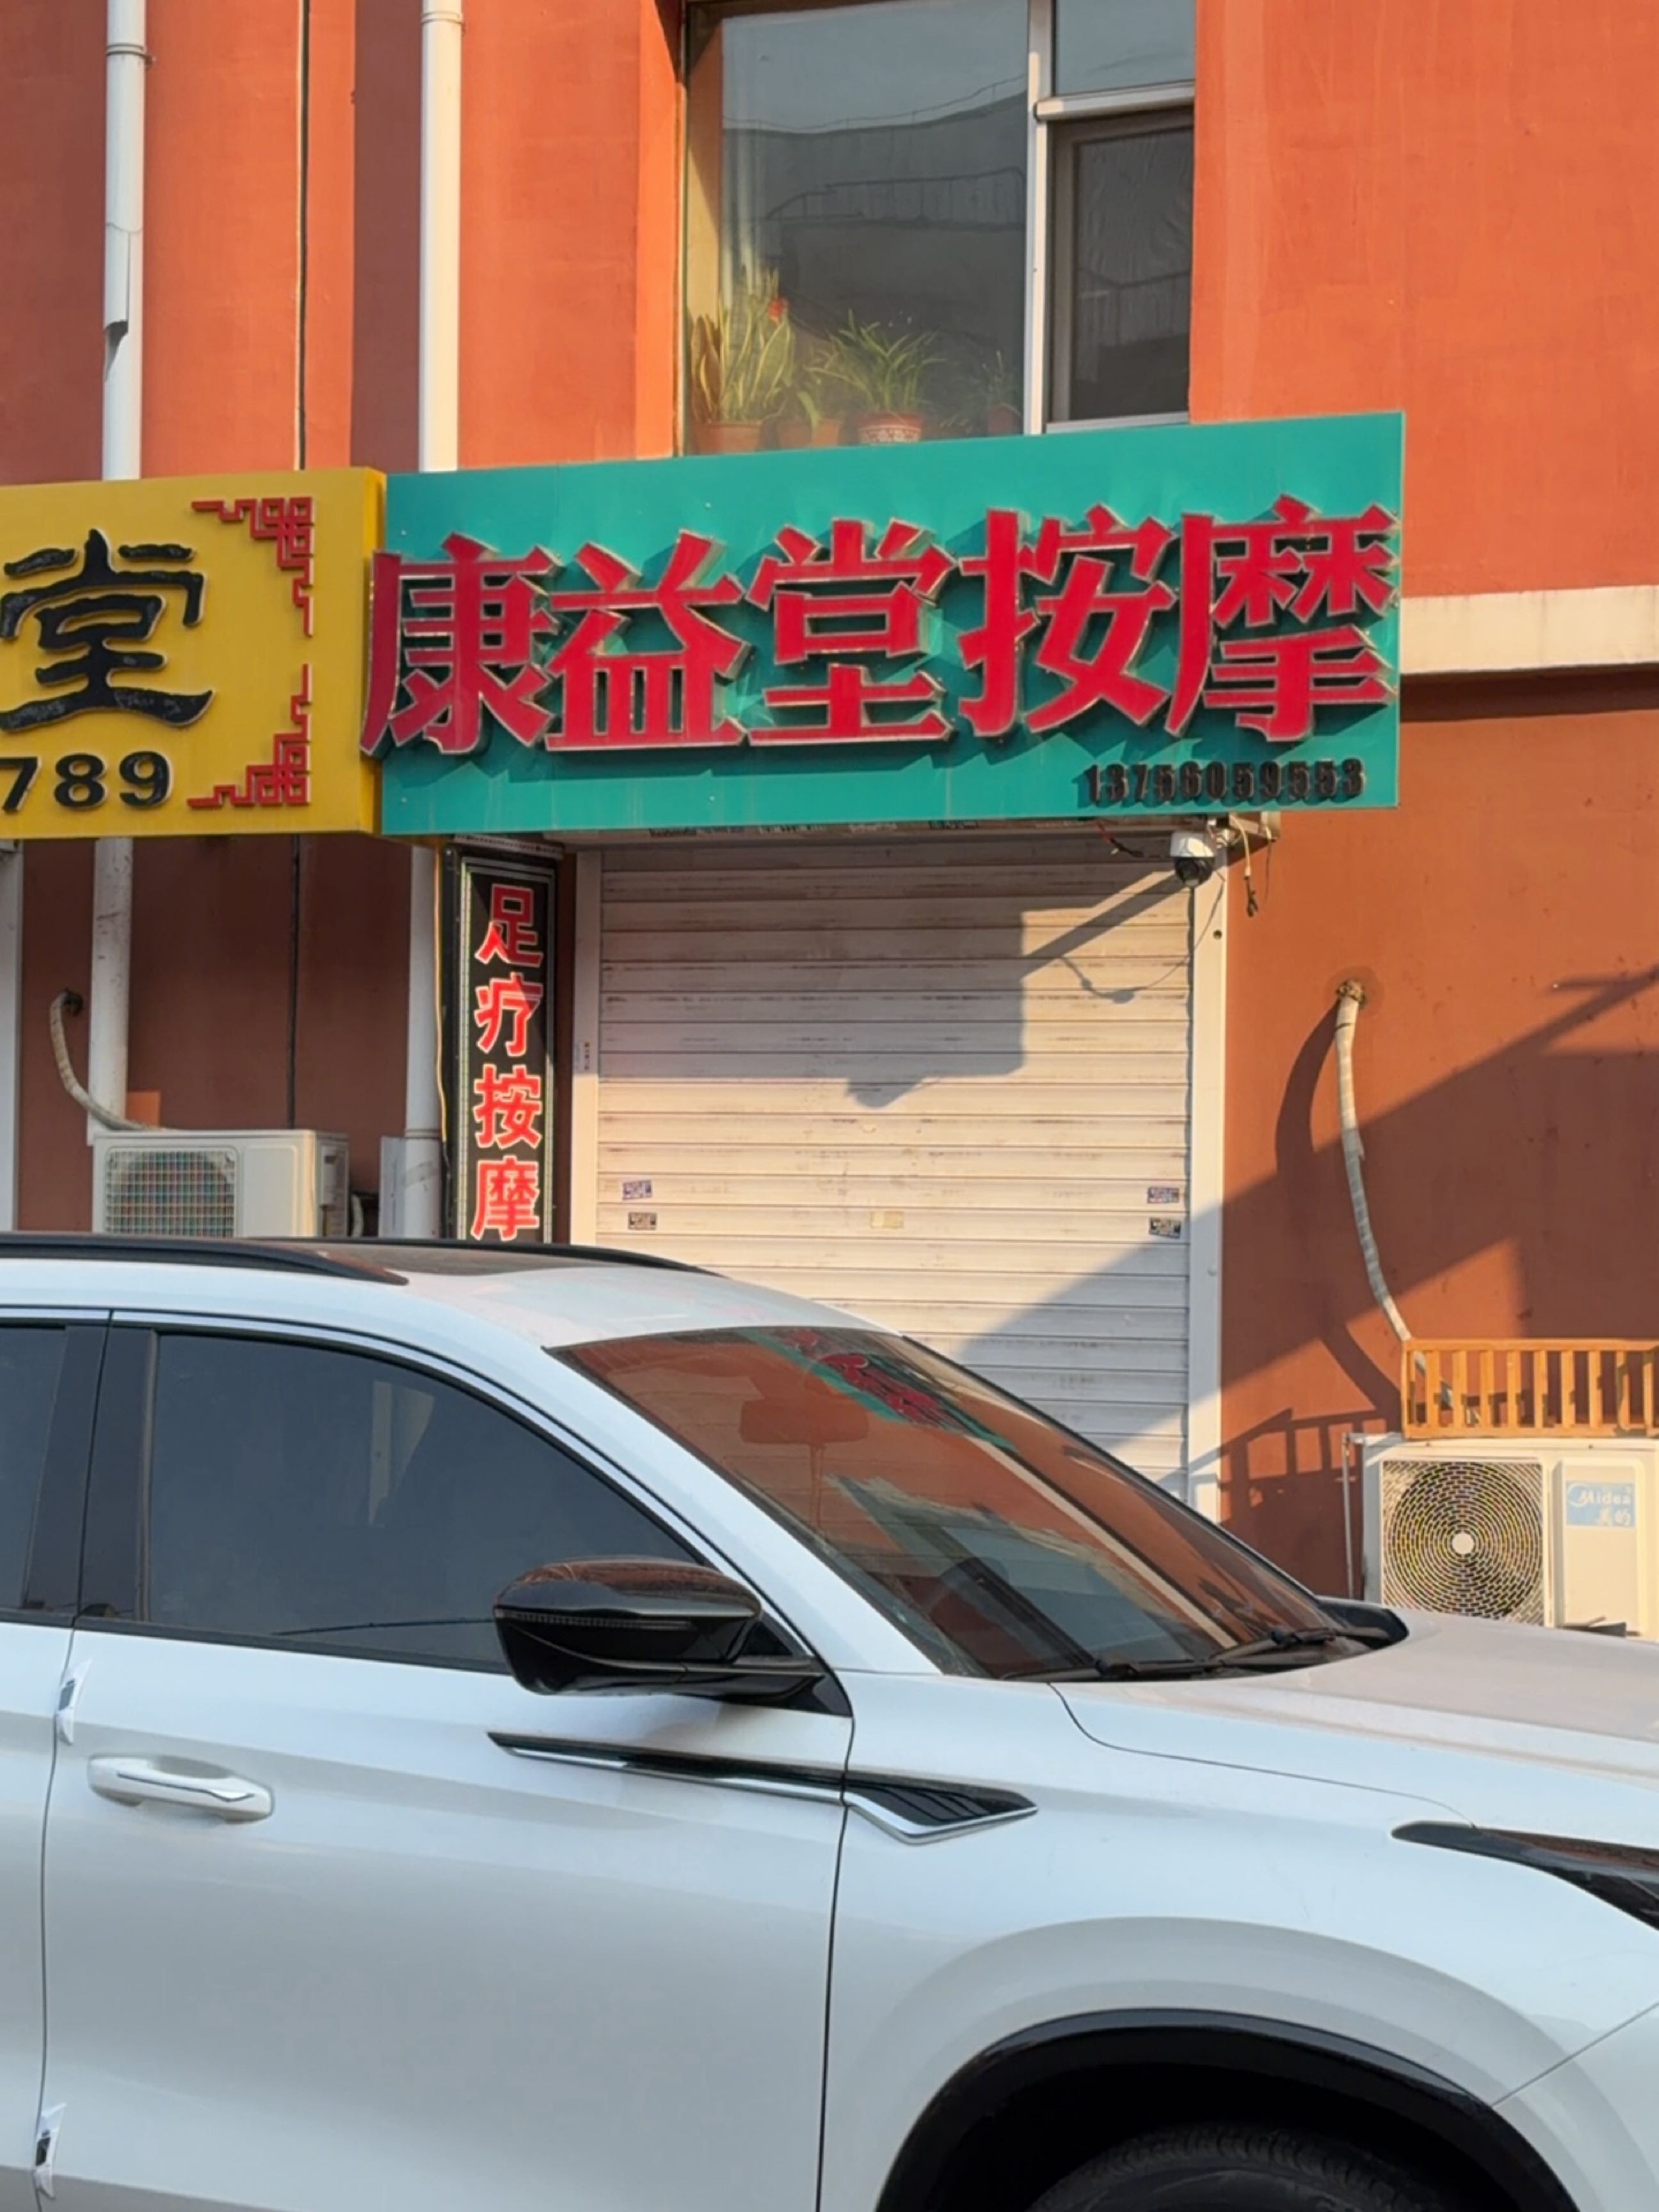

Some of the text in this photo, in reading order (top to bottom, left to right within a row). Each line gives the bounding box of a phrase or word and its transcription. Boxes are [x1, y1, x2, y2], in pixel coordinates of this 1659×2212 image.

[0, 528, 213, 732] 堂
[360, 493, 1398, 755] 康益堂按摩
[0, 750, 174, 814] 789
[1086, 758, 1366, 805] 13756059553
[470, 883, 544, 1242] 足疗按摩
